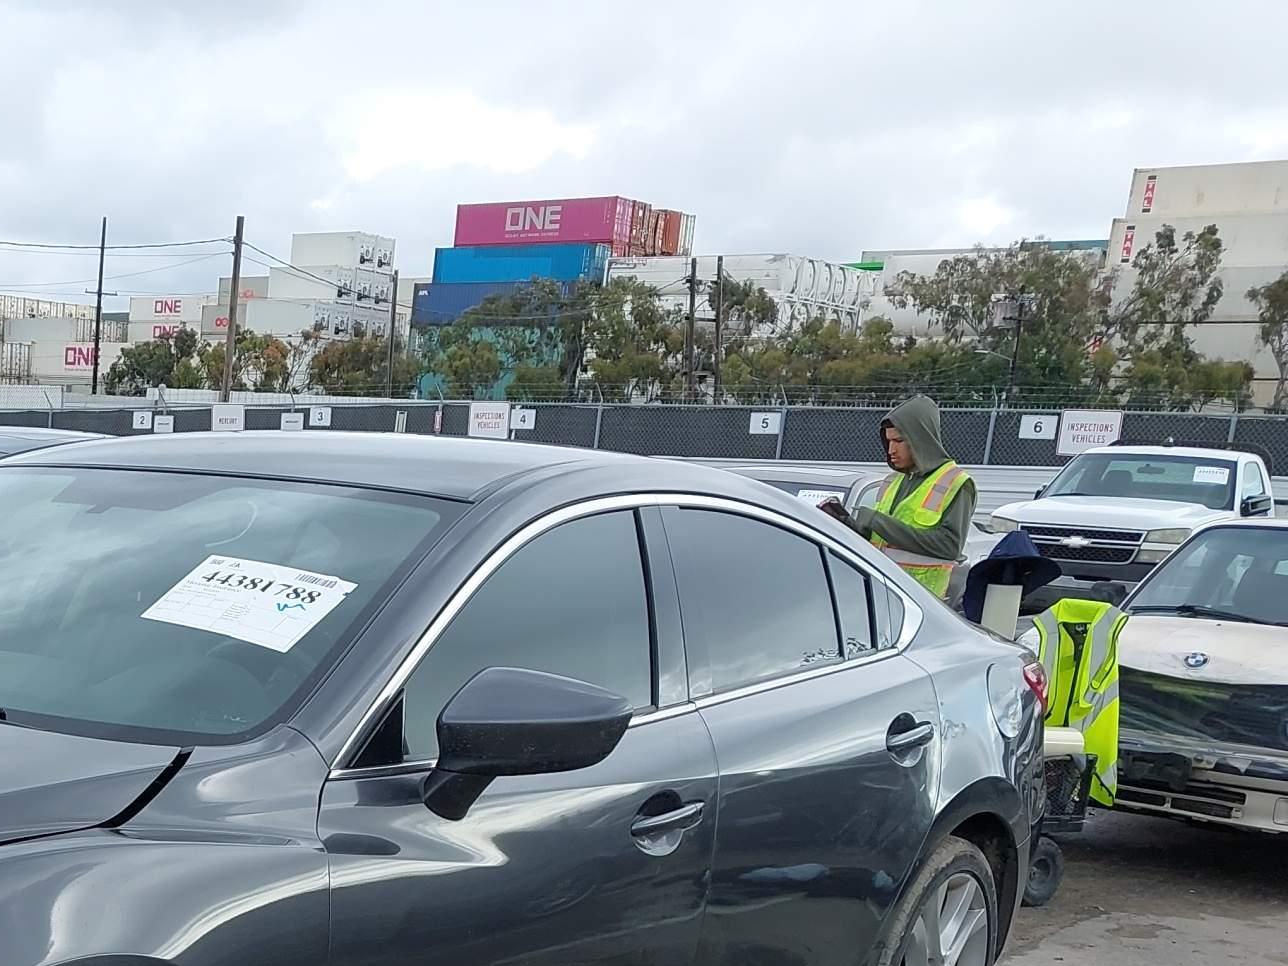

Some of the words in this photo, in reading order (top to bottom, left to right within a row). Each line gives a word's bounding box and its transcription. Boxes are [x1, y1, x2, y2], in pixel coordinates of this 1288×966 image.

[1143, 181, 1155, 207] TAL
[505, 206, 561, 231] ONE
[1122, 231, 1134, 257] TAL
[154, 300, 181, 313] ONE
[139, 415, 145, 424] 2
[318, 412, 324, 421] 3
[473, 411, 505, 420] INSPECTIONS
[519, 414, 527, 424] 4
[477, 421, 500, 429] VEHICLES
[761, 417, 770, 429] 5
[1033, 421, 1044, 433] 6
[1067, 422, 1114, 432] INSPECTIONS
[1072, 434, 1106, 443] VEHICLES
[201, 570, 321, 604] 44381788
